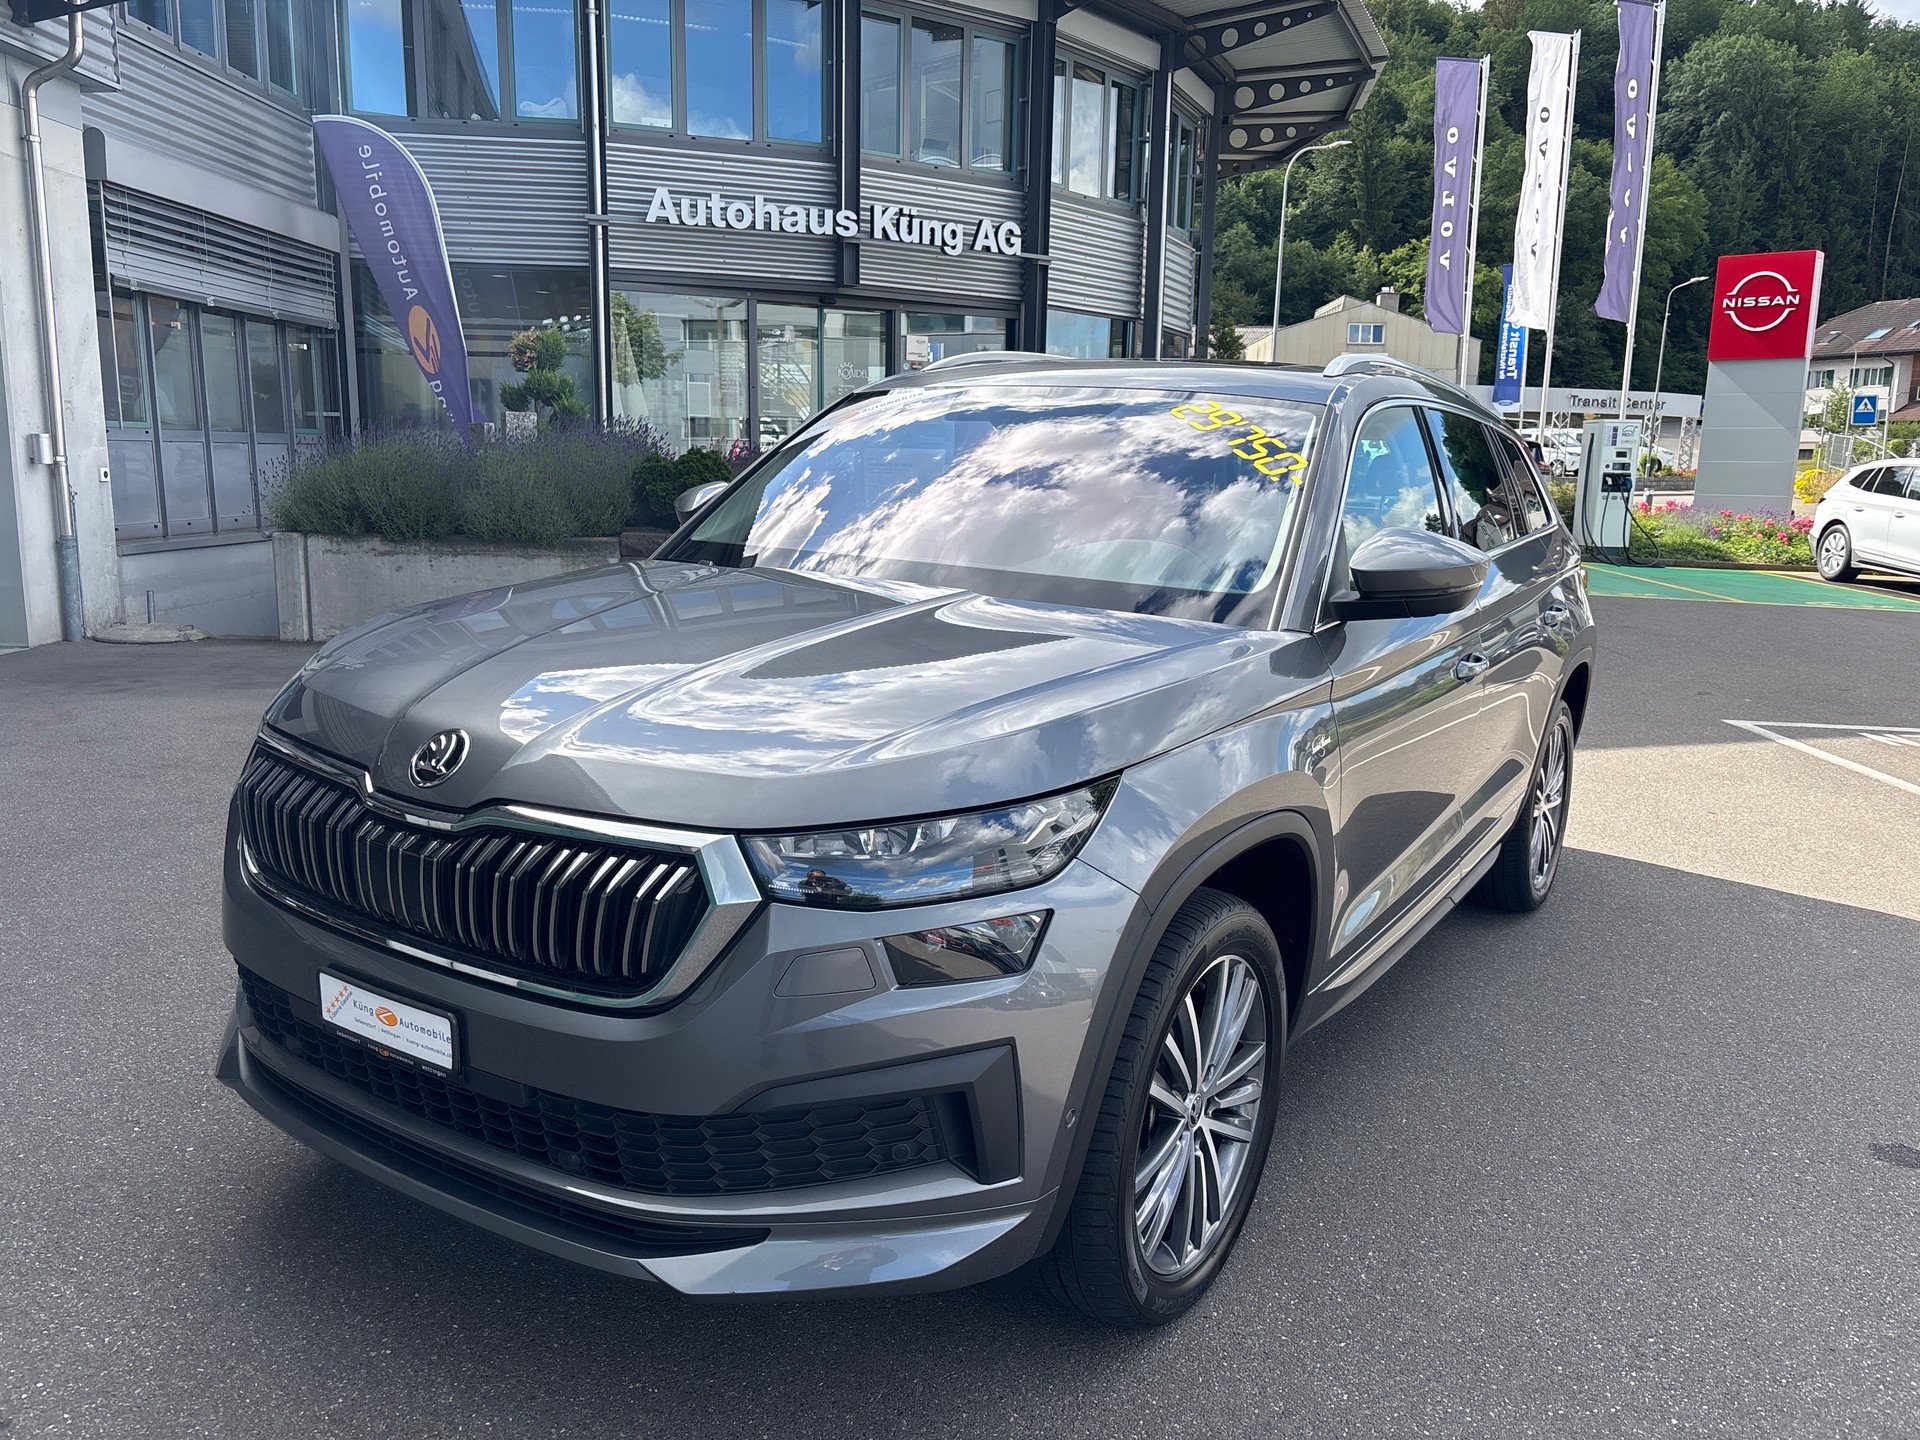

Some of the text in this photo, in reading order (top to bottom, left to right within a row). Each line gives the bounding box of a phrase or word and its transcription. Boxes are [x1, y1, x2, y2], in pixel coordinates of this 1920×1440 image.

[645, 186, 1022, 256] Autohaus Küng AG
[1722, 294, 1800, 308] NISSAN
[1570, 394, 1617, 409] Transit
[352, 999, 452, 1044] Küng Automobile
